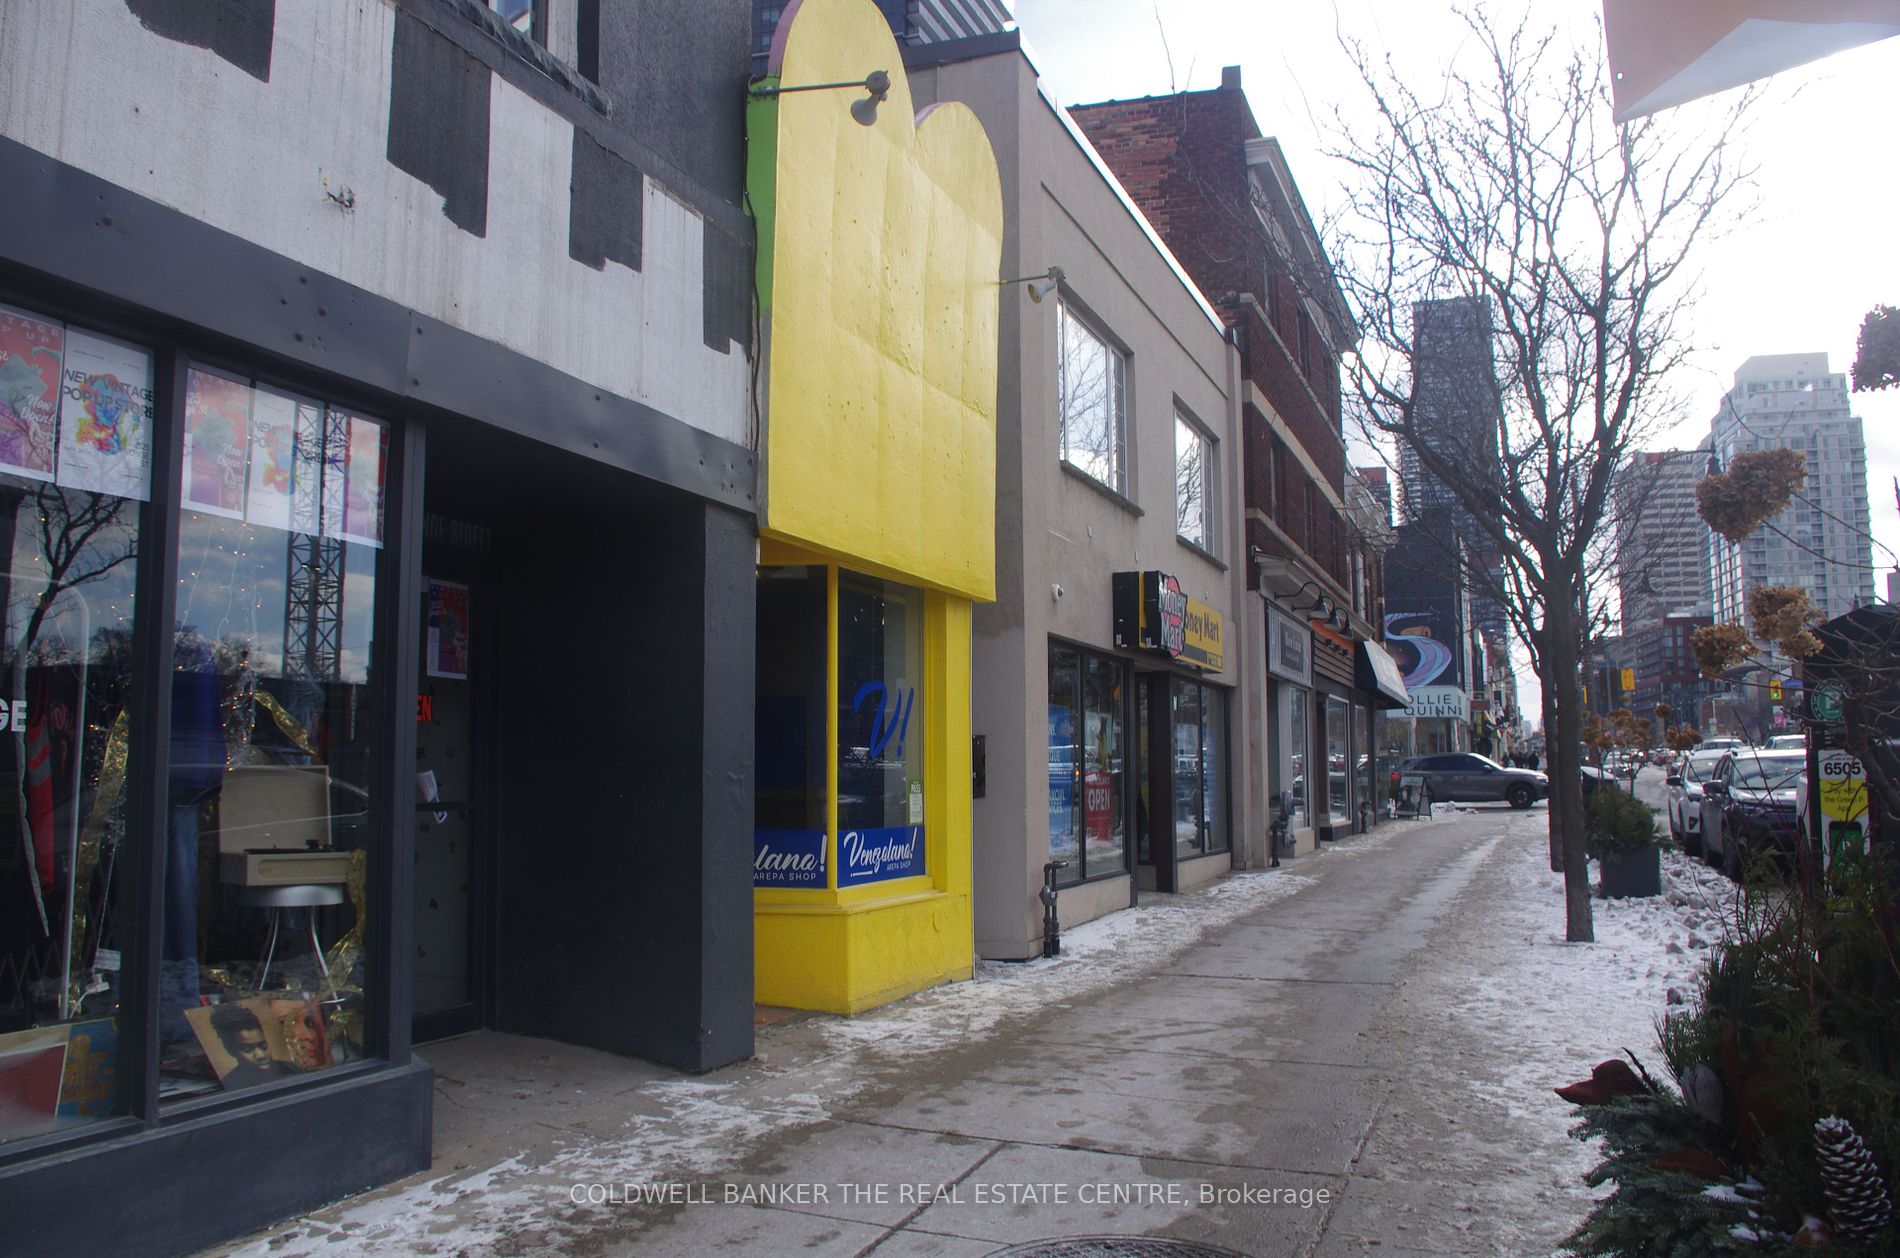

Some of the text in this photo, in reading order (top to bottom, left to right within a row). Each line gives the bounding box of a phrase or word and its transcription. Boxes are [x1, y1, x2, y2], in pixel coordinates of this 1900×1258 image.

[1158, 572, 1187, 618] Money
[1160, 612, 1185, 655] Mart
[1204, 611, 1219, 643] Mart
[852, 680, 915, 761] V!
[1403, 705, 1457, 716] QUINN
[1824, 762, 1861, 776] 6505
[1088, 788, 1111, 812] OPEN
[754, 872, 817, 881] AREPA SHOP
